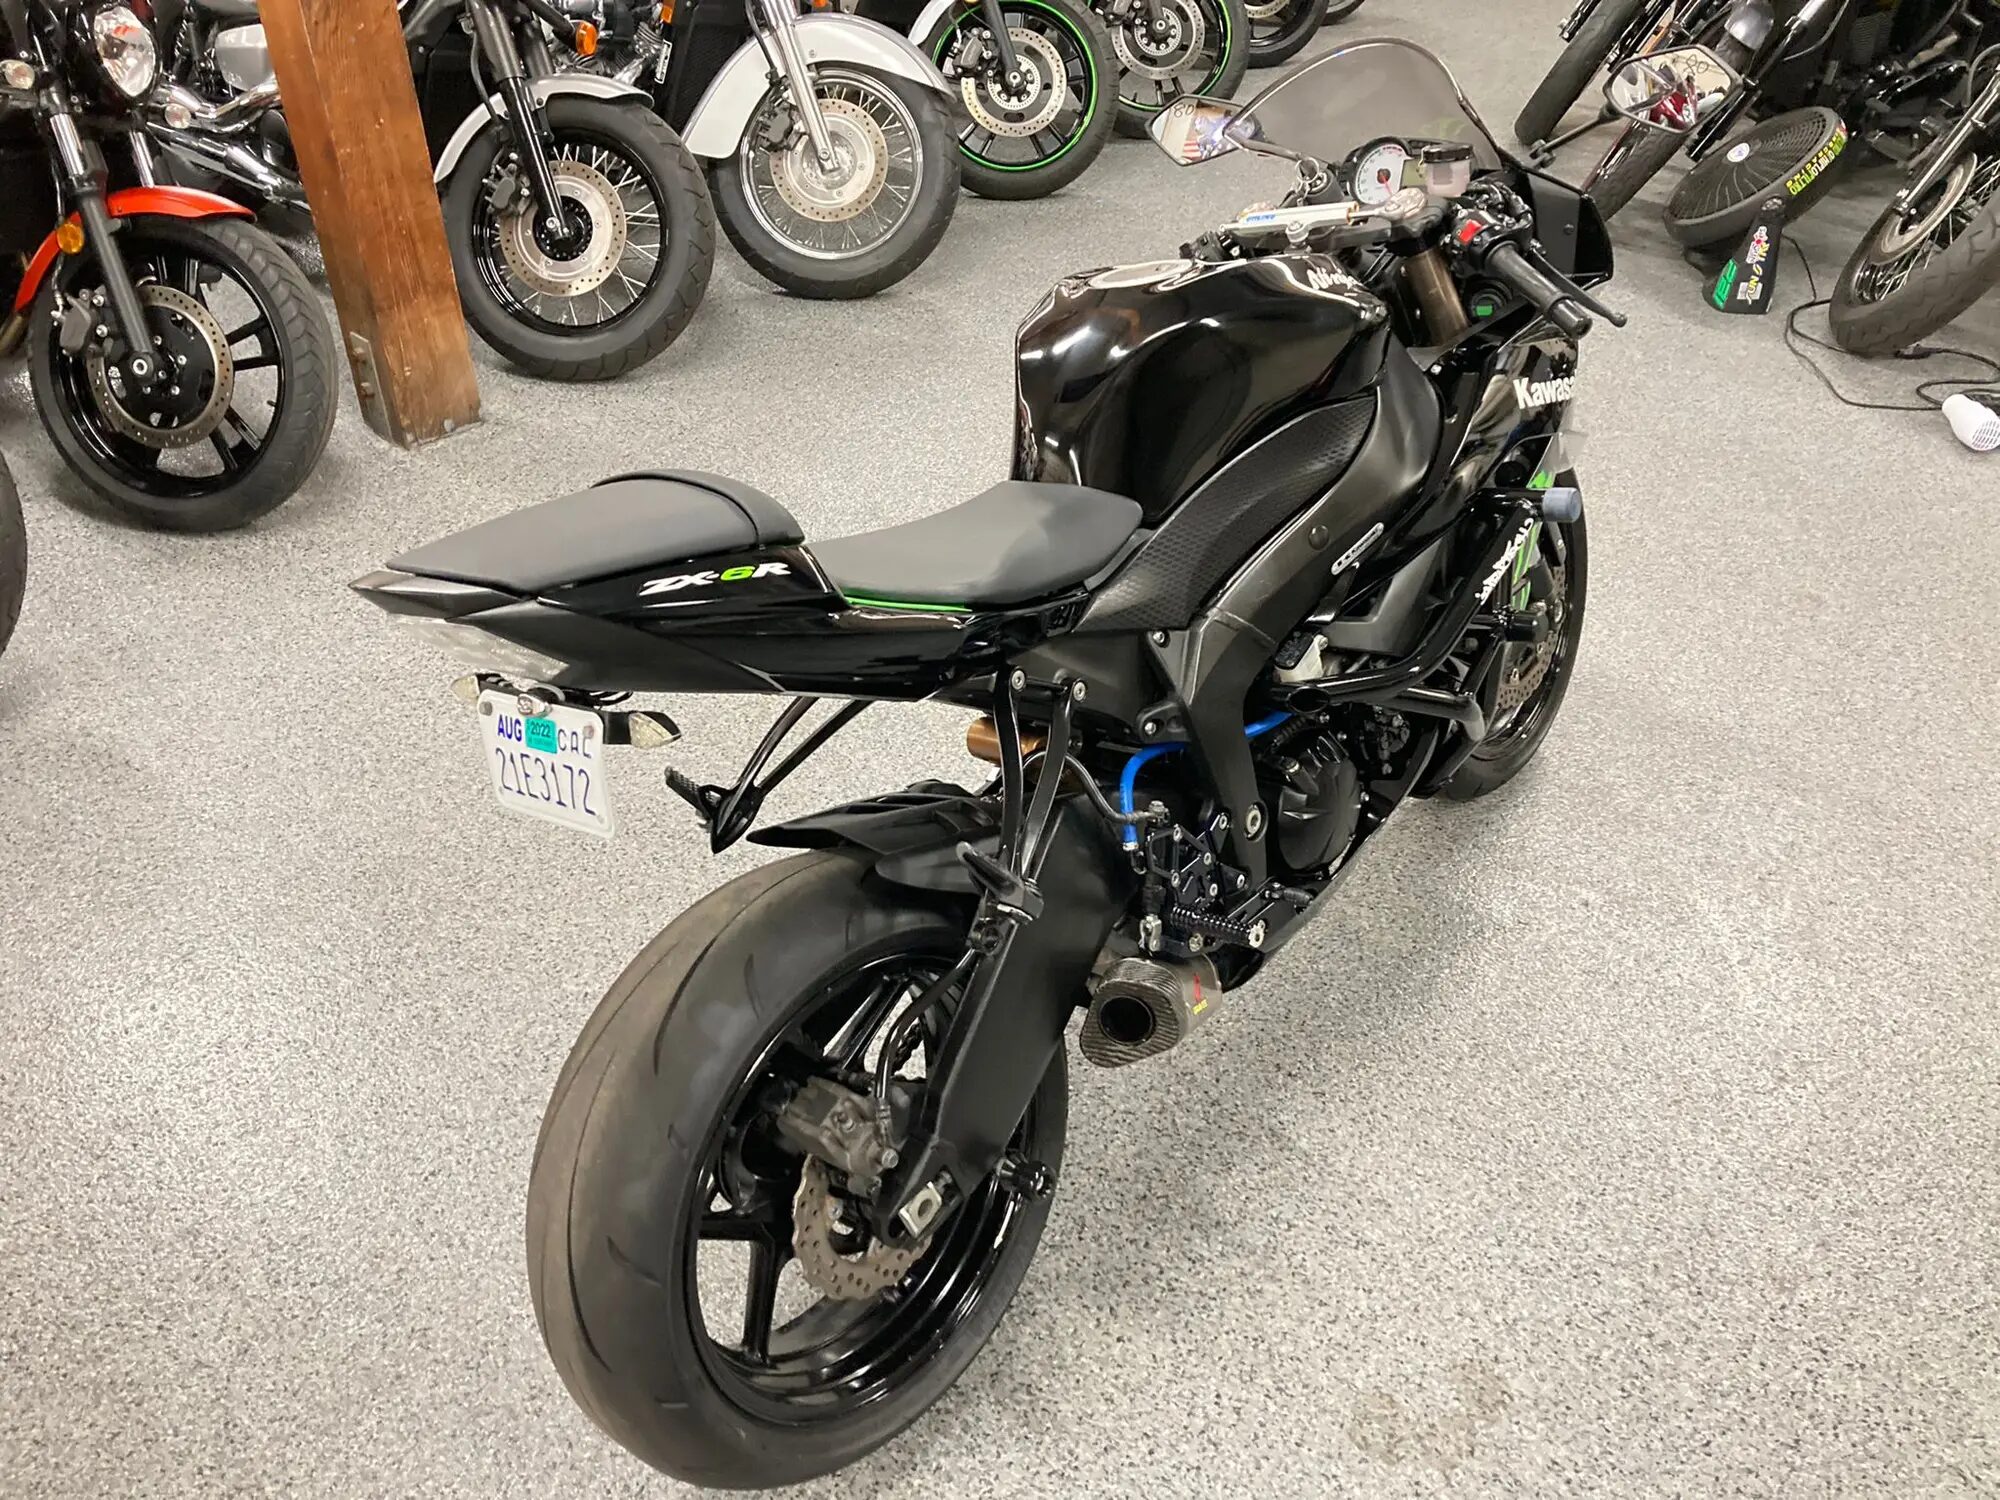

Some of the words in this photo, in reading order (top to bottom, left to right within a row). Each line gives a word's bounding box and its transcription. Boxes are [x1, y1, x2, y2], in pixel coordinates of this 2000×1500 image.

[638, 562, 792, 596] ZX-6R
[497, 714, 523, 742] AUG
[530, 722, 552, 738] 2022
[495, 746, 597, 816] 21E3172
